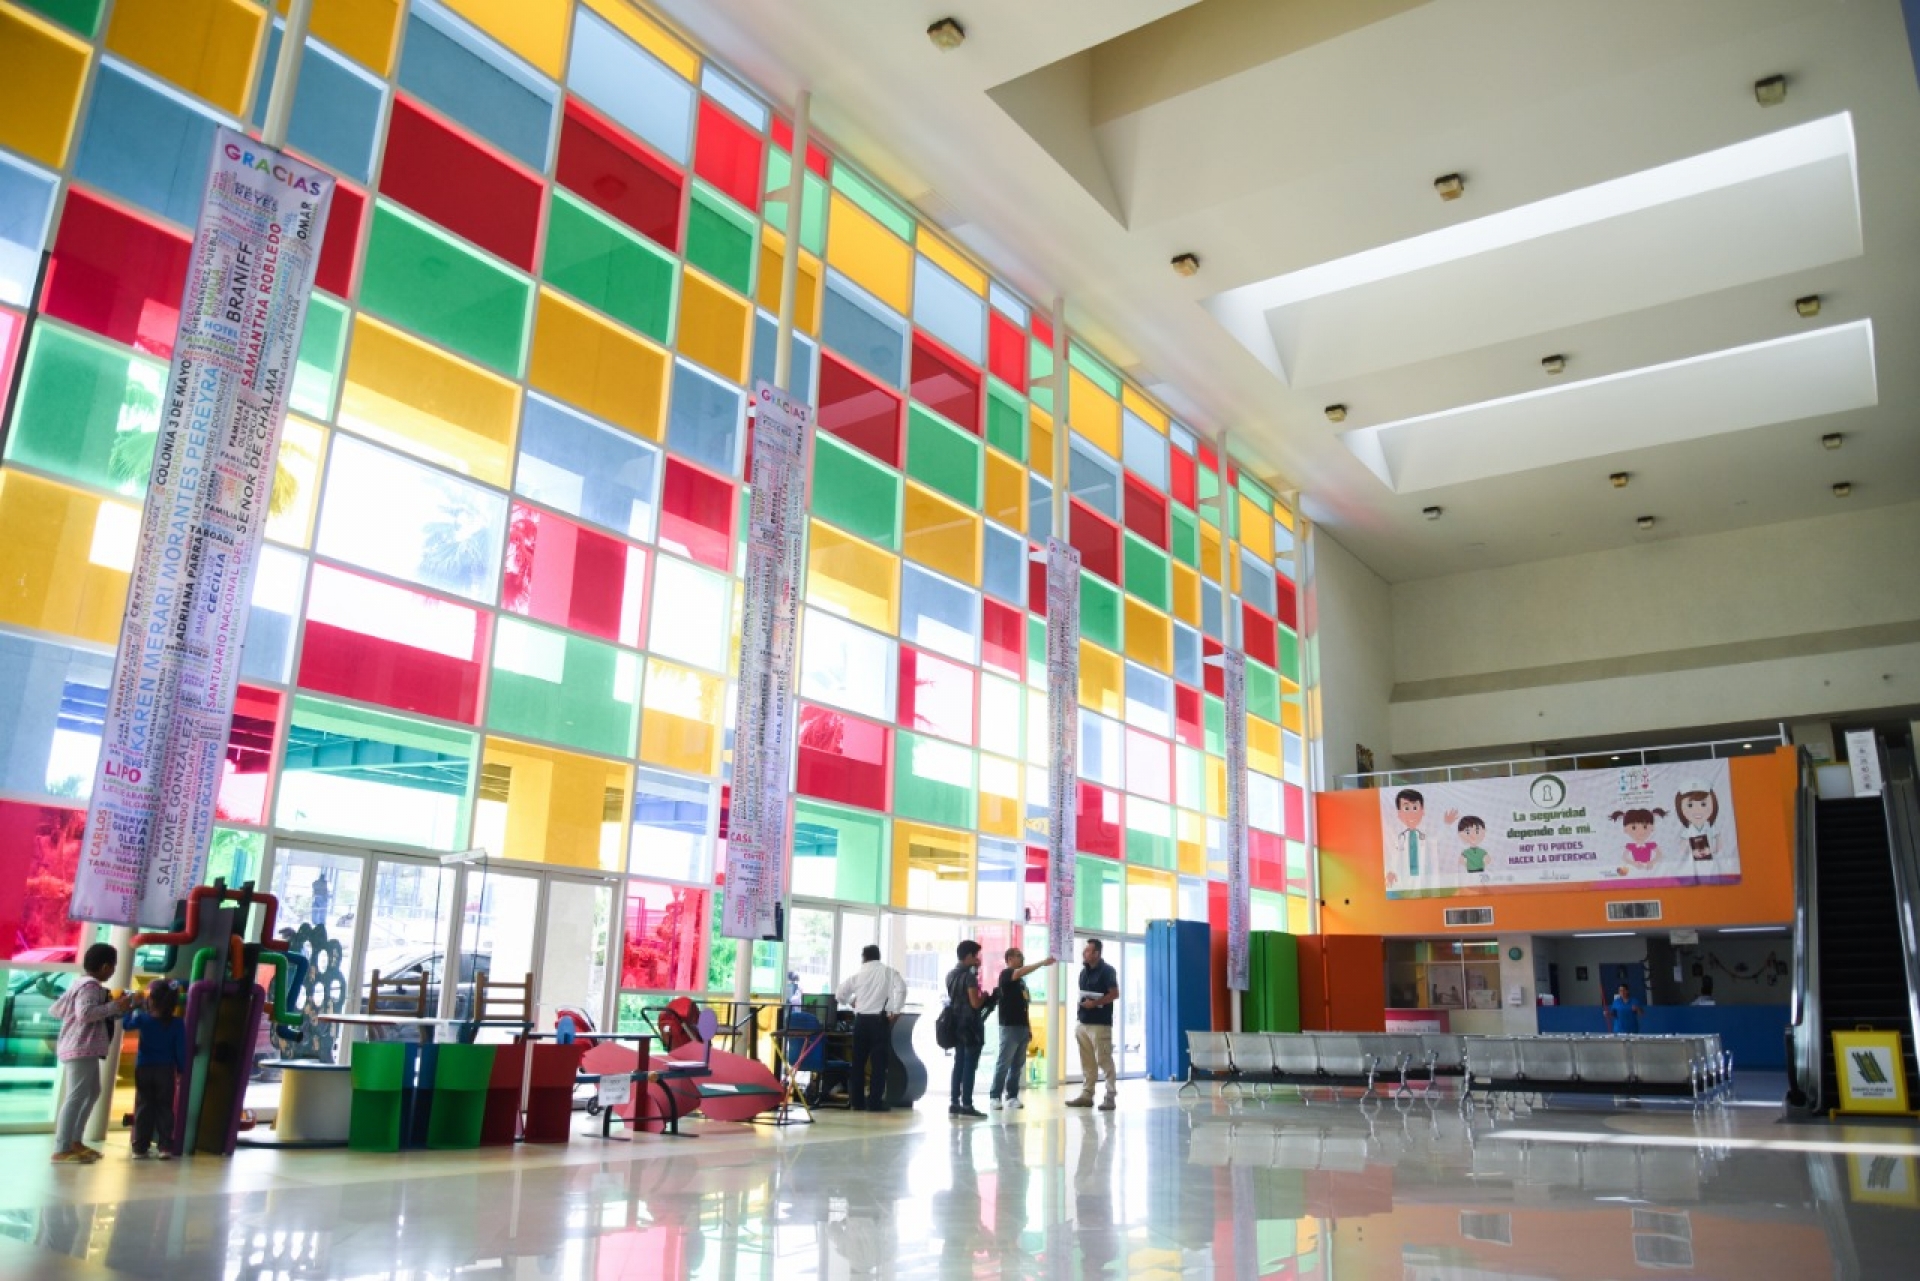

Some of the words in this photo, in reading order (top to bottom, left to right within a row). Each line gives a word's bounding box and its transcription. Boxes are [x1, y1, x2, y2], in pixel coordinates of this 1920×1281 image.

[223, 141, 321, 197] GRACIAS
[295, 199, 311, 240] OMAR
[225, 241, 253, 323] BRANIFF
[240, 297, 269, 387] SAMANTHA
[258, 222, 282, 294] ROBLEDO
[175, 357, 192, 397] MAYO
[170, 398, 183, 418] DE
[254, 365, 279, 440] CHALMA
[168, 419, 179, 428] 3
[155, 429, 177, 486] COLONIA
[248, 443, 263, 469] DE
[189, 524, 234, 546] TABOADA
[232, 538, 244, 565] DEL
[128, 676, 156, 751] KAREN
[142, 584, 174, 671] MERARI
[160, 464, 199, 580] MORANTES
[184, 364, 220, 461] PEREYRA
[175, 580, 194, 640] ADRIANA
[187, 535, 202, 579] PARRA
[207, 551, 225, 614] CECILIA
[219, 567, 239, 632] NACIONAL
[206, 633, 227, 708] SANTUARIO
[155, 722, 166, 739] DE
[159, 702, 170, 719] LA
[104, 759, 142, 784] LIPO
[200, 742, 217, 806] OCAMPO
[173, 802, 189, 861] FERNANDO
[182, 753, 195, 799] AGUILAR
[1513, 811, 1526, 822] La
[1530, 807, 1586, 822] seguridad
[90, 808, 107, 856] CARLOS
[117, 832, 146, 845] OLEA
[156, 812, 178, 885] SALOMÉ
[194, 809, 208, 850] TELLO
[1507, 825, 1554, 840] depende
[1558, 825, 1572, 834] de
[1519, 844, 1534, 852] HOY
[1537, 843, 1548, 851] TU
[1551, 842, 1583, 850] PUEDES
[1509, 856, 1534, 864] HACER
[1537, 855, 1547, 863] LA
[1548, 852, 1596, 862] DIFERENCIA
